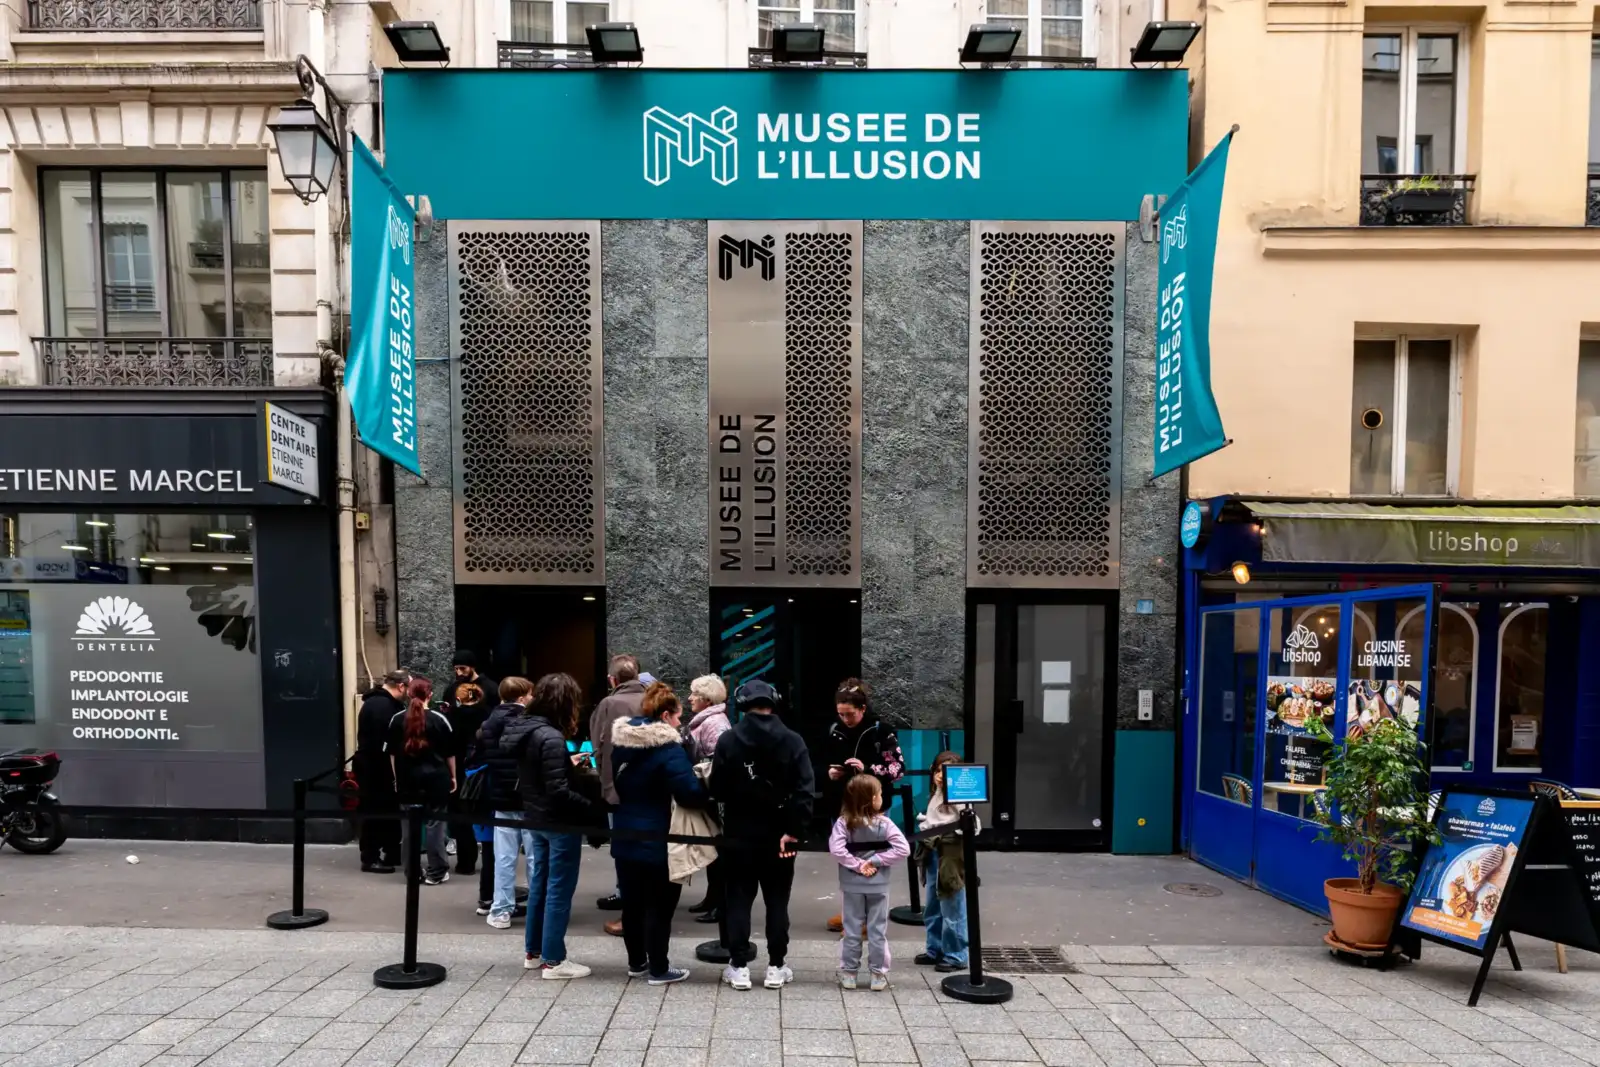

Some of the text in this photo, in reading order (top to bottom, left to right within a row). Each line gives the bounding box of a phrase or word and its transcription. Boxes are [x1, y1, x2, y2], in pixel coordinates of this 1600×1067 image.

[757, 113, 981, 143] MUSEE DE
[757, 150, 981, 180] L'ILLUSION
[390, 272, 403, 445] MUSEE DE
[401, 284, 414, 451] L'ILLUSION
[1159, 282, 1171, 453] MUSEE DE
[1171, 271, 1186, 447] L'ILLUSION
[271, 412, 306, 438] CENTRE
[271, 430, 316, 458] DENTAIRE
[272, 447, 304, 469] ETIENNE
[130, 469, 253, 492] MARCEL
[273, 464, 305, 485] MARCEL
[719, 414, 741, 571] MUSEE DE
[754, 414, 776, 571] L'ILLUSION
[1429, 530, 1518, 557] libshop
[77, 643, 155, 652] DENTELIA
[1282, 648, 1321, 666] libshop
[1364, 640, 1406, 653] CUISINE
[1358, 655, 1411, 667] LIBANAISE
[70, 670, 164, 683] PEDODONTIE
[71, 689, 189, 703] IMPLANTOLOGIE
[1285, 745, 1307, 755] FALAFEL
[1280, 758, 1311, 769] CHAWARMA
[1448, 817, 1516, 833] shawarmas falafels
